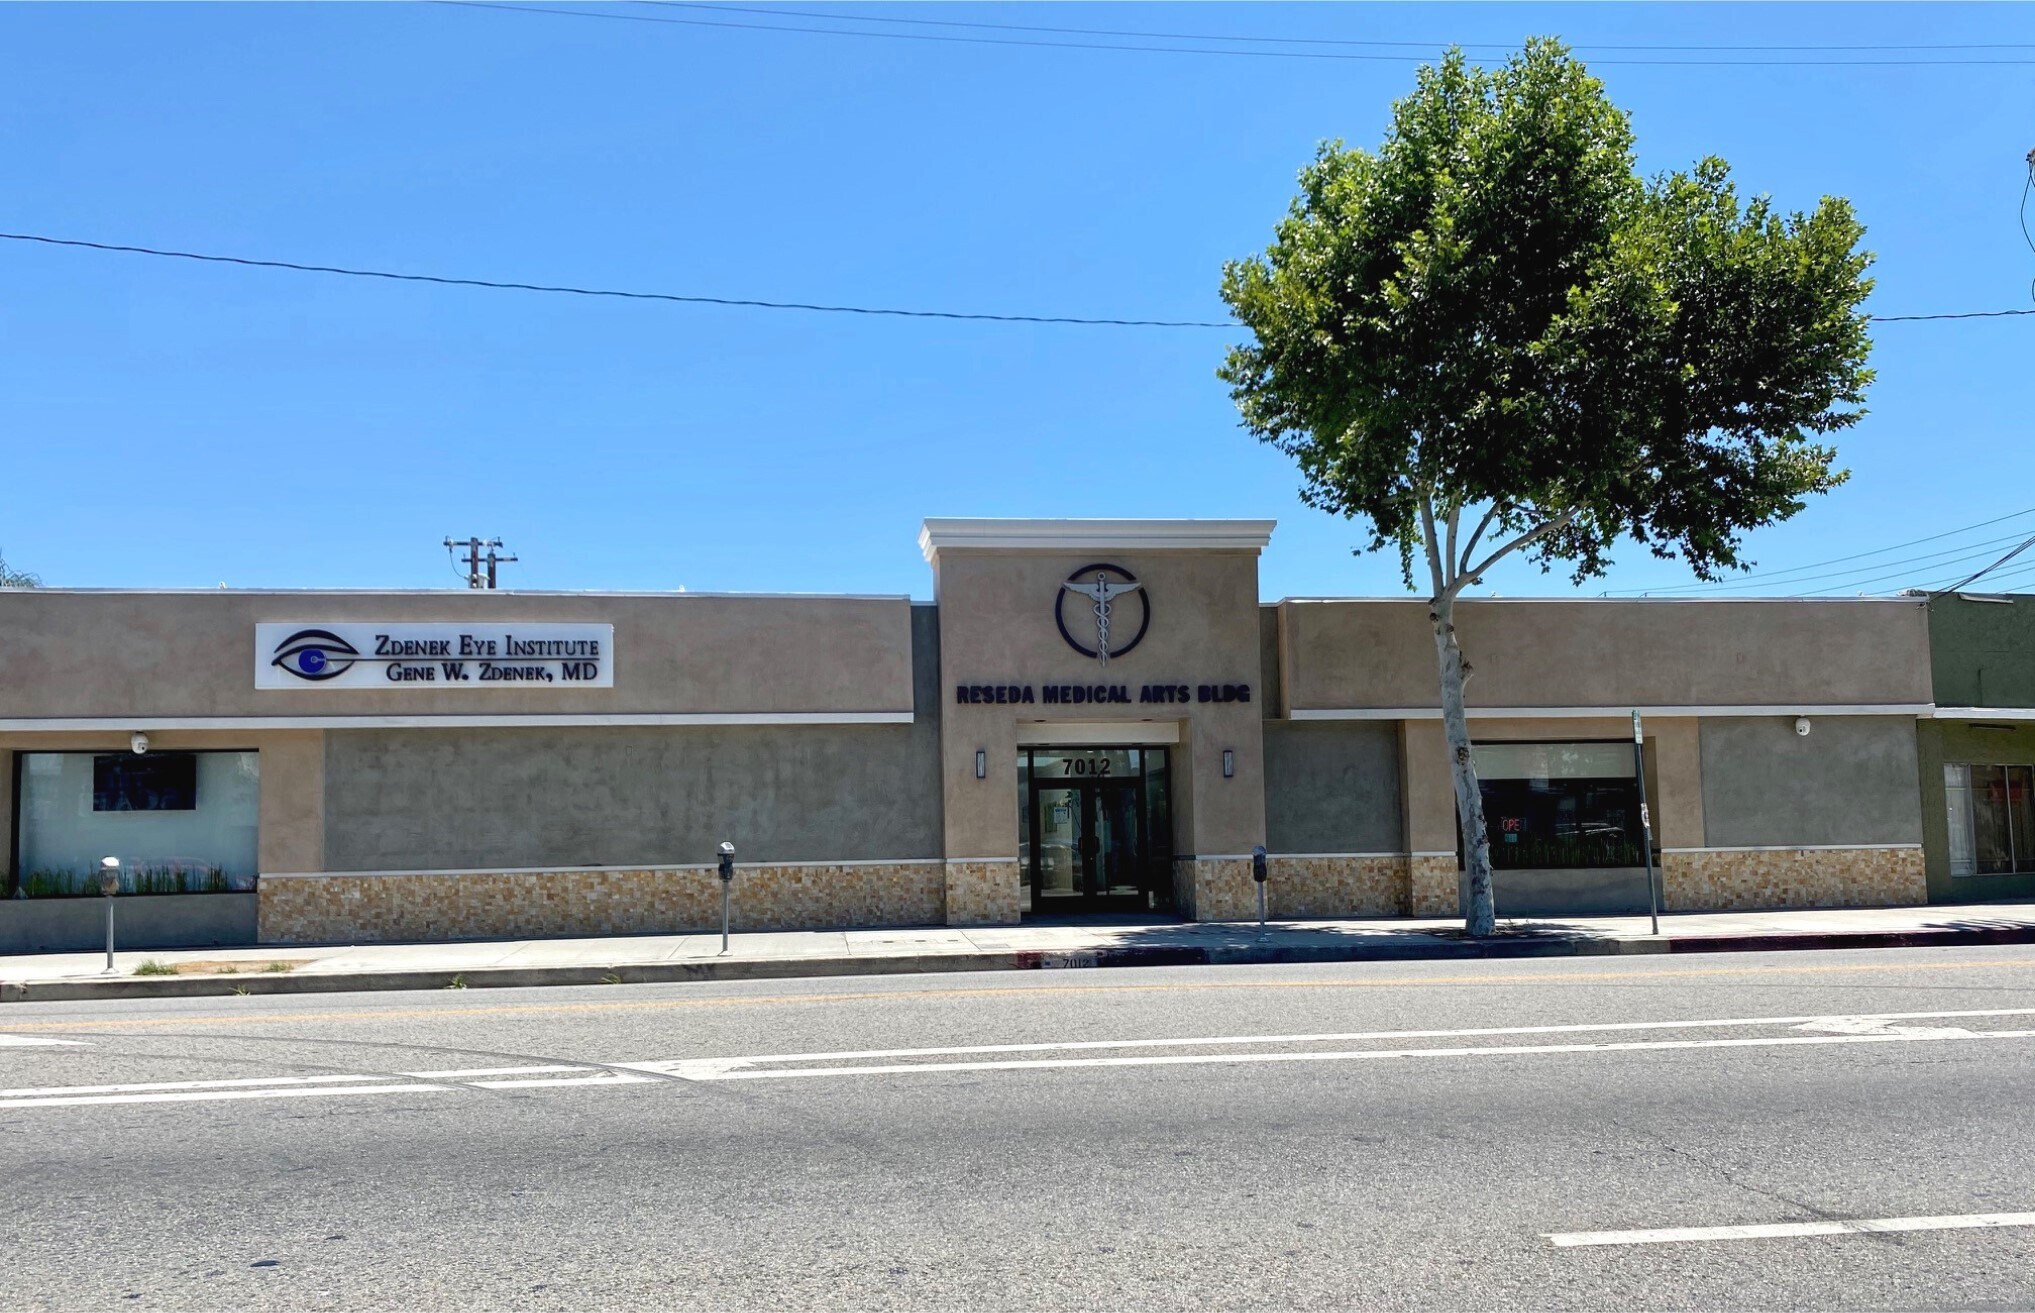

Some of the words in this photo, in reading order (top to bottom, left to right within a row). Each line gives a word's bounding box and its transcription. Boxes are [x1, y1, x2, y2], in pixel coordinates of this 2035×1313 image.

[375, 634, 451, 656] ZDENEK
[458, 634, 497, 656] EYE
[505, 634, 599, 656] INSTITUTE
[386, 662, 435, 682] GENE
[441, 662, 469, 681] W.
[478, 662, 553, 683] ZDENEK,
[561, 662, 598, 681] MD
[957, 685, 1035, 704] RESEDA
[1042, 685, 1132, 704] MEDICAL
[1140, 684, 1191, 703] ARTS
[1198, 684, 1251, 703] BLDG
[1062, 758, 1111, 776] 7012
[1063, 958, 1090, 969] 7012
